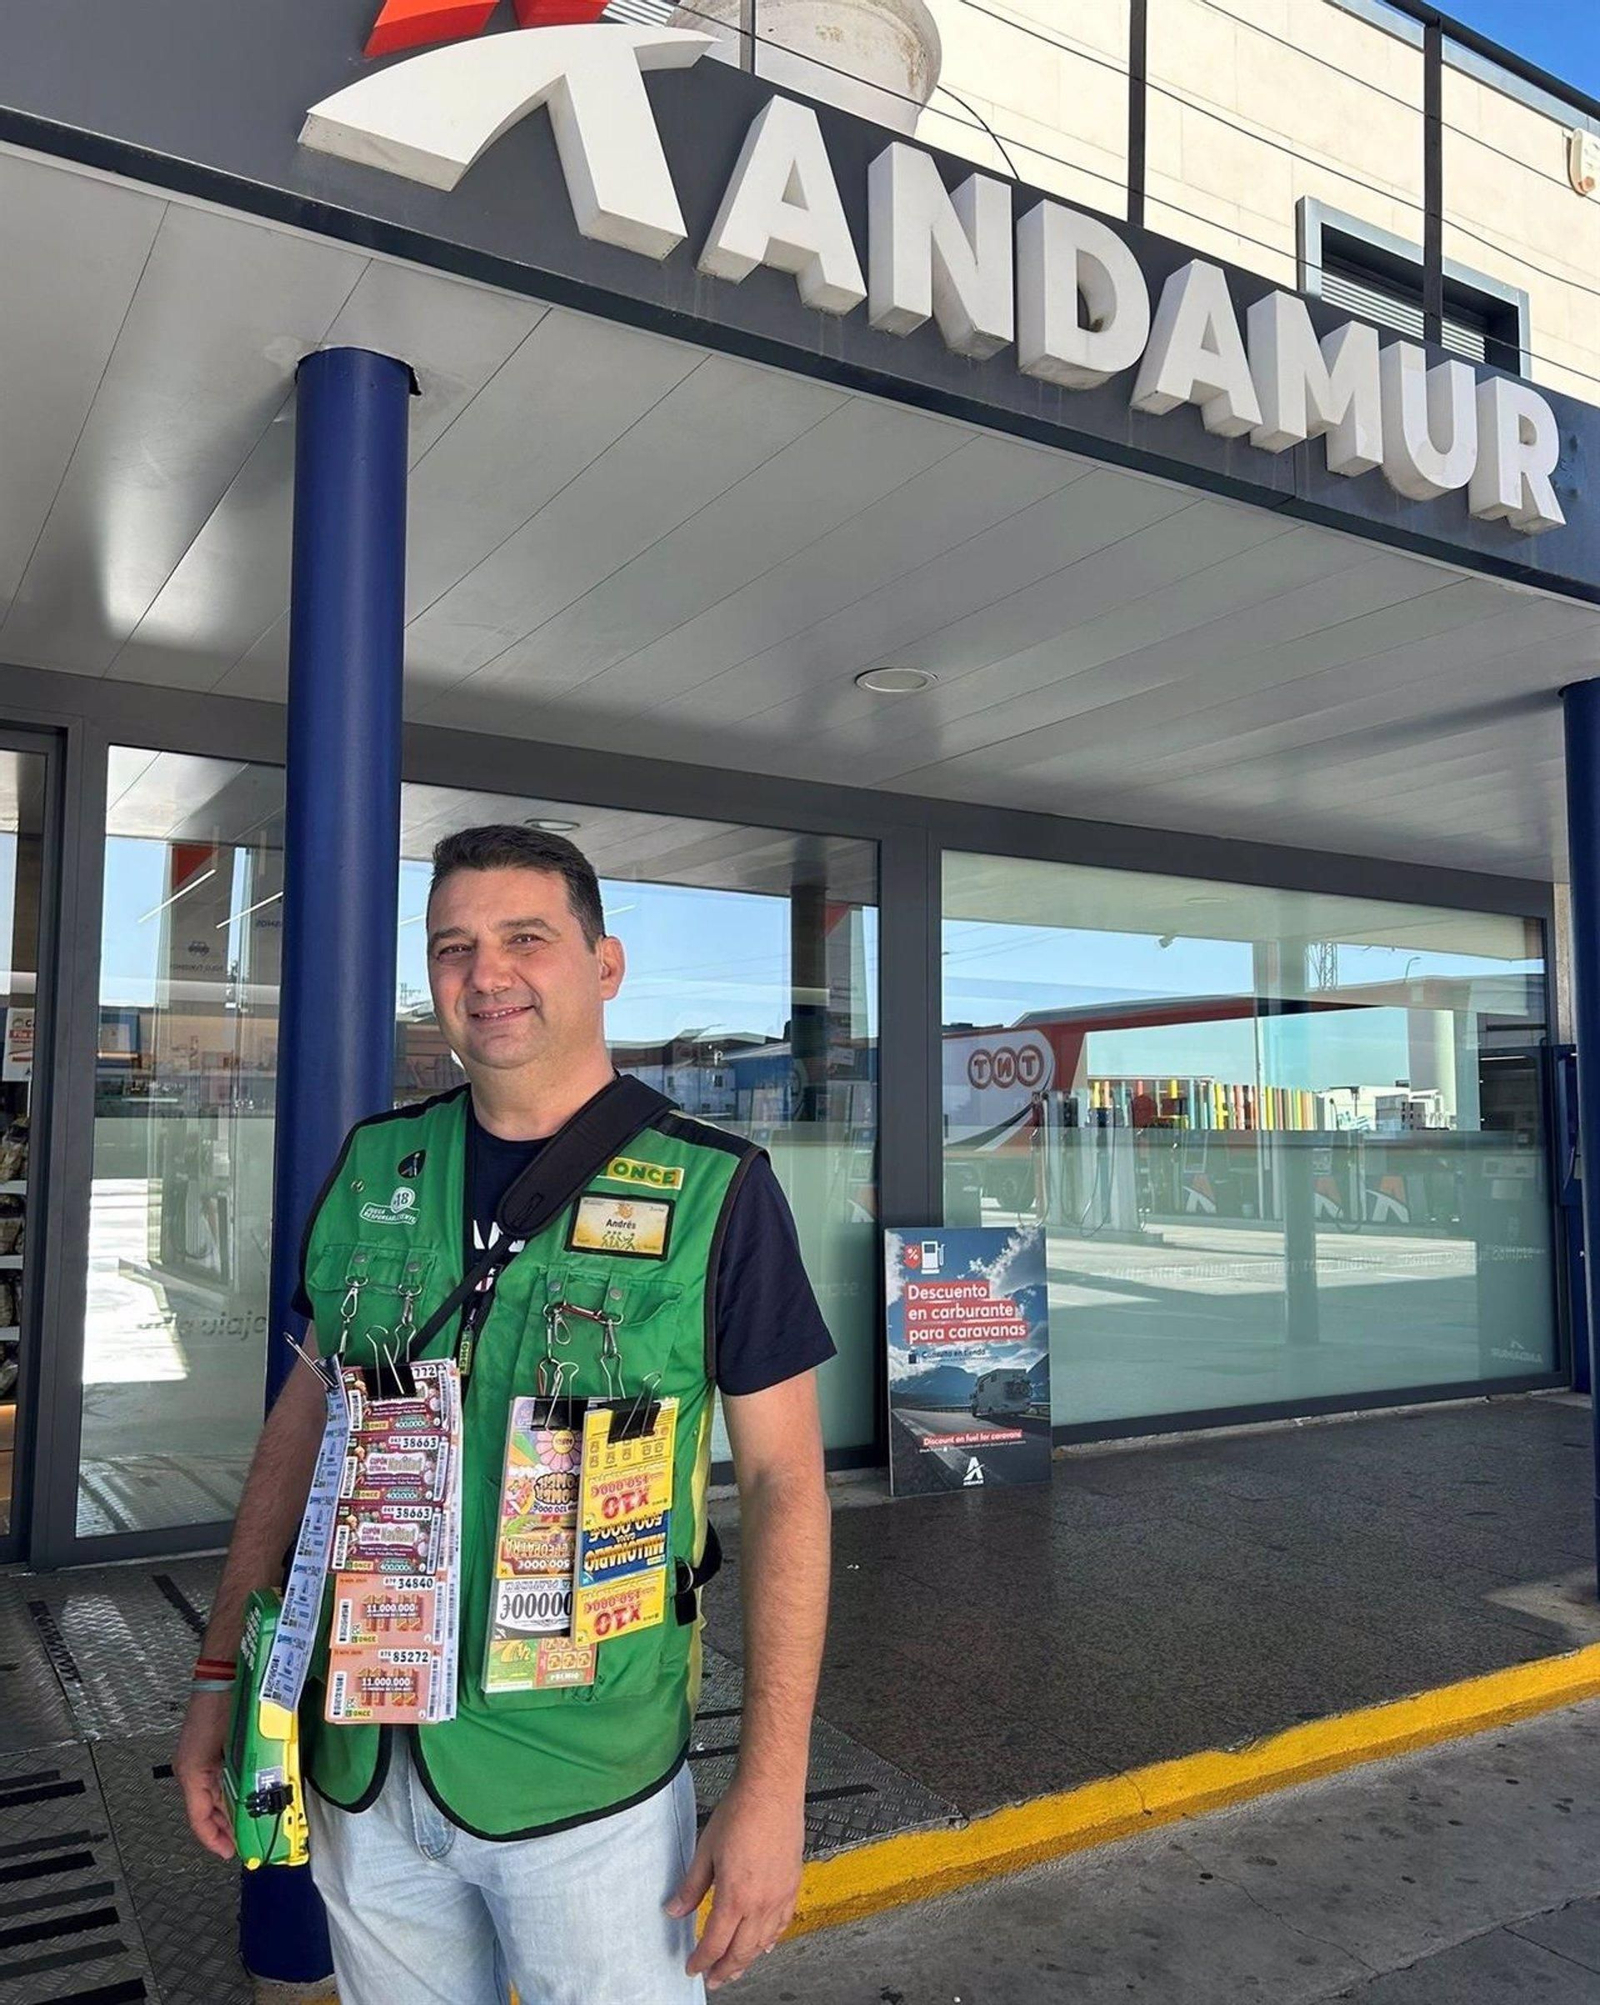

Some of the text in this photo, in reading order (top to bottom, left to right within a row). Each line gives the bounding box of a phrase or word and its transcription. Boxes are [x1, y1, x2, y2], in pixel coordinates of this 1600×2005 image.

[697, 94, 1567, 534] ANDAMUR
[613, 1162, 676, 1184] ONCE
[606, 1219, 637, 1230] Andrés
[908, 1284, 988, 1300] Descuento
[908, 1302, 1013, 1320] en carburante
[908, 1325, 1026, 1344] para caravanas
[402, 1437, 437, 1448] 38663
[361, 1490, 378, 1498] ONCE
[602, 1489, 649, 1519] X10
[395, 1507, 430, 1519] 38663
[505, 1539, 568, 1557] CLEOPATRA
[583, 1532, 666, 1571] MILLONARIO
[354, 1562, 372, 1570] ONCE
[518, 1559, 570, 1569] 500.000€
[397, 1577, 433, 1589] 34840
[594, 1605, 641, 1636] X10
[359, 1635, 376, 1643] ONCE
[393, 1651, 429, 1663] 85272
[353, 1708, 371, 1717] ONCE
